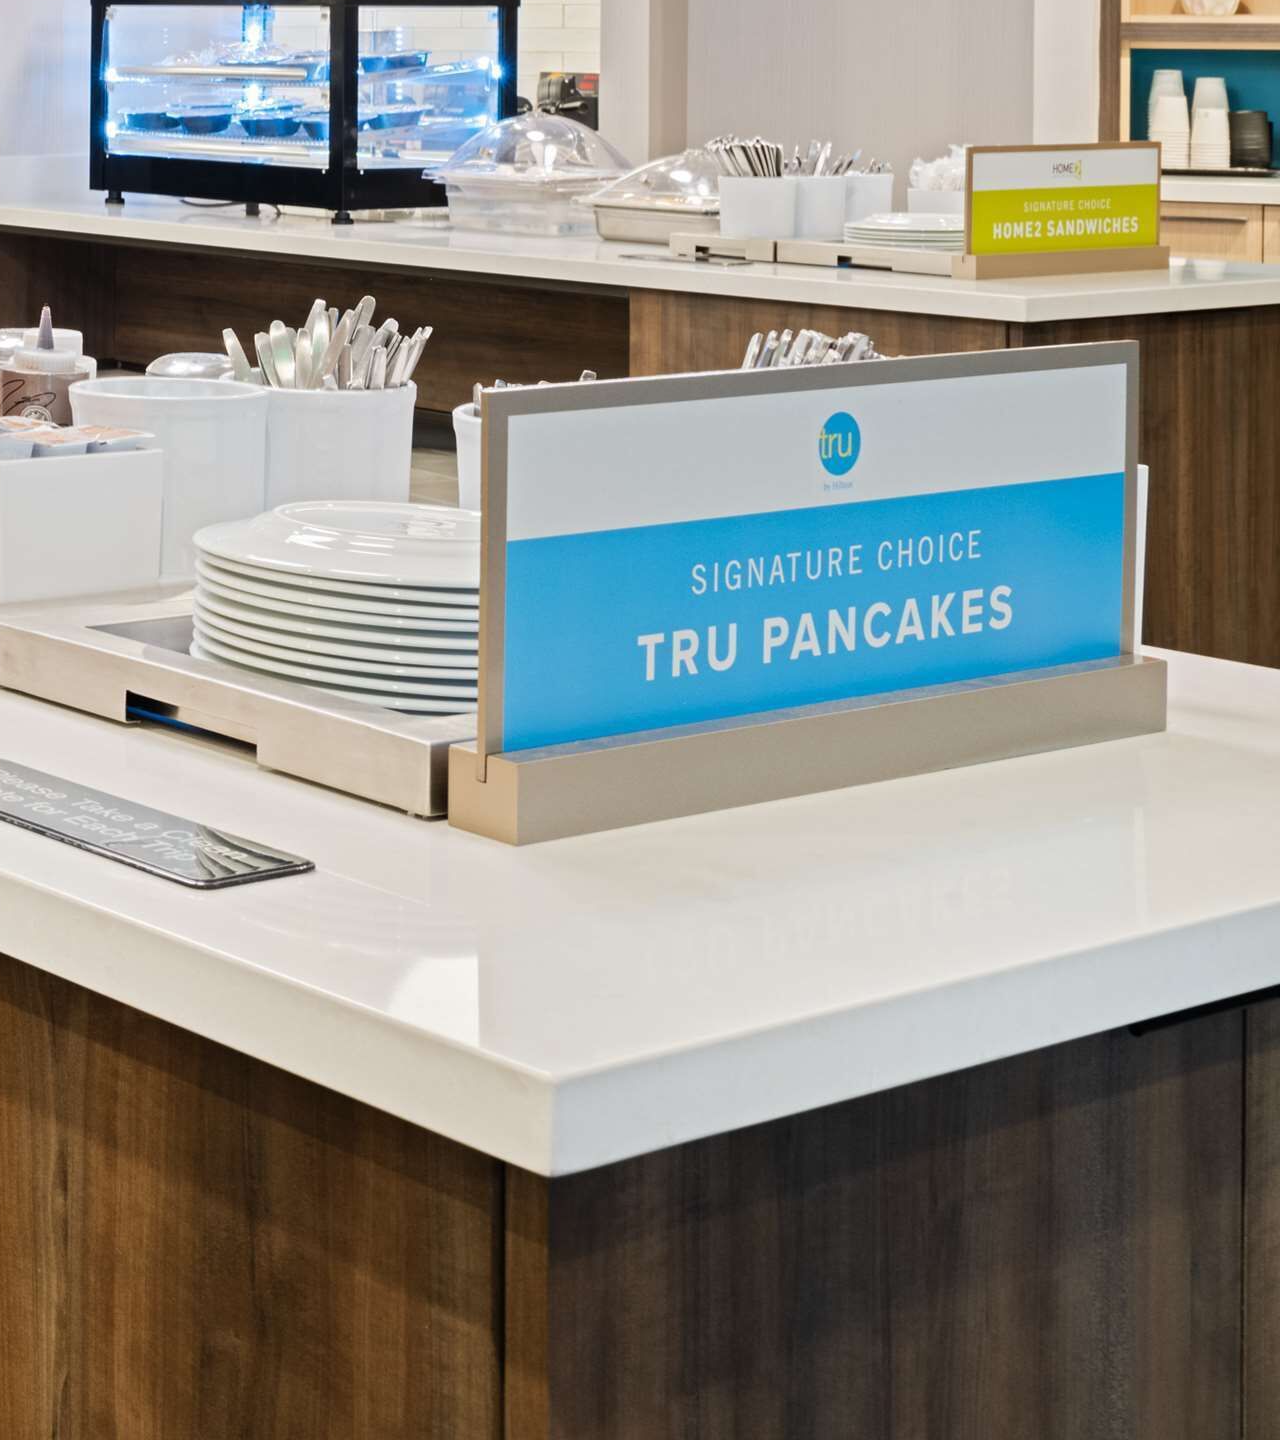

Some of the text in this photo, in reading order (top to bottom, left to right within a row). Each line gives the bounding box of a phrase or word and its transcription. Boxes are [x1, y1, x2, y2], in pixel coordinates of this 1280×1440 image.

[1023, 198, 1112, 213] SIGNATURE CHOICE
[992, 216, 1139, 240] HOME2 SANDWICHES
[816, 426, 853, 459] tru
[690, 529, 982, 596] SIGNATURE CHOICE
[637, 584, 1014, 682] TRU PANCAKES
[71, 797, 135, 822] Take
[23, 801, 69, 815] for
[63, 814, 141, 841] Each
[142, 838, 198, 862] Trip
